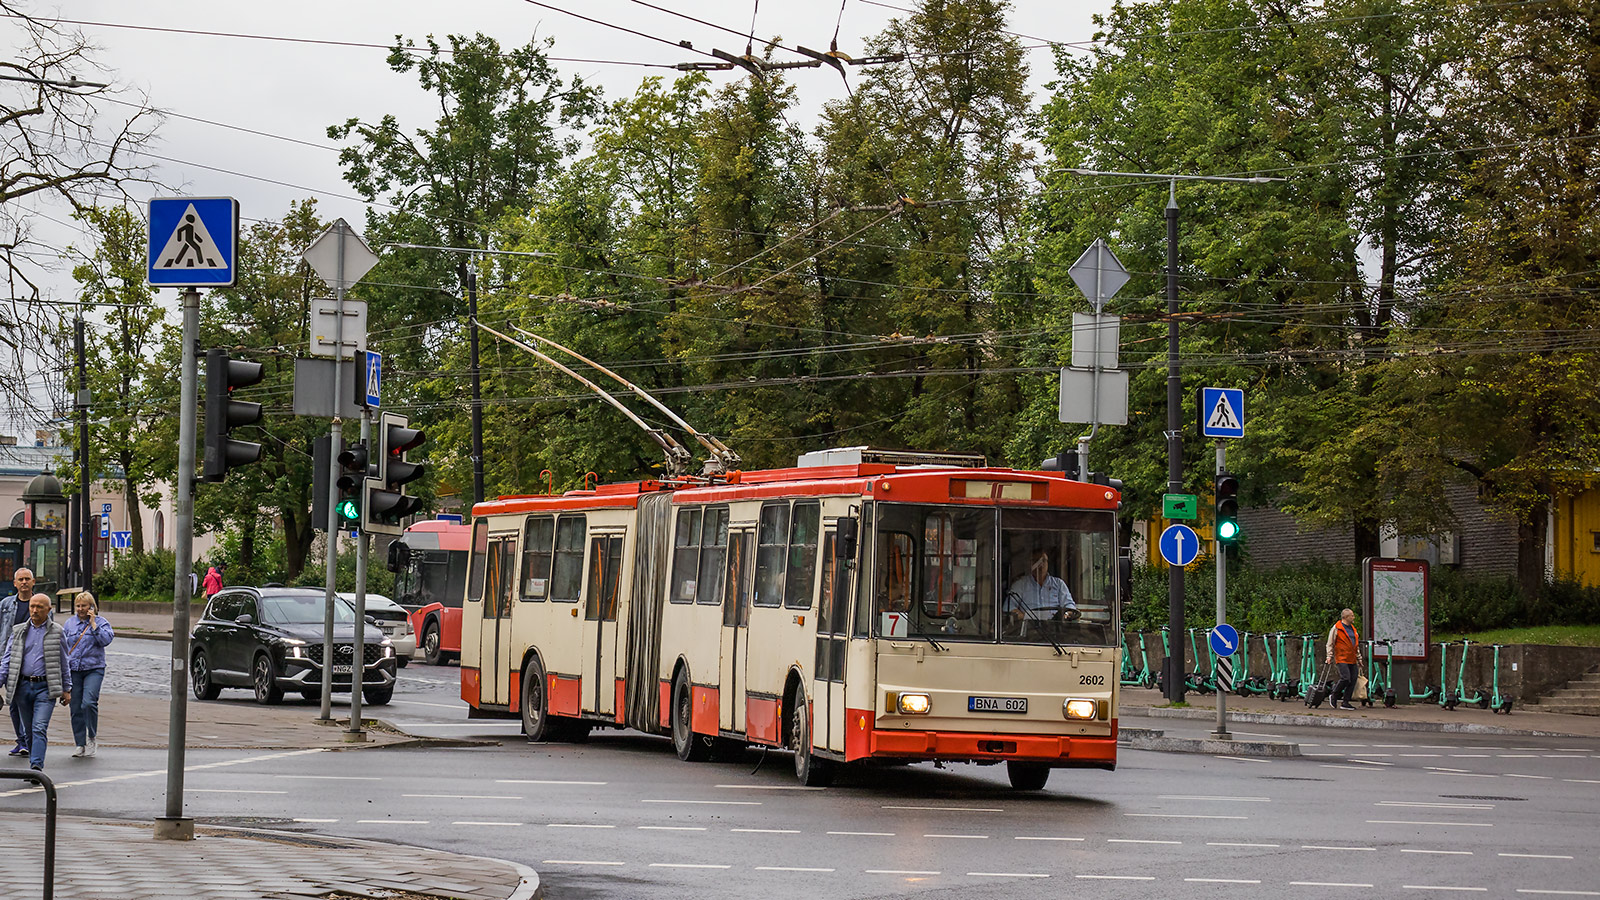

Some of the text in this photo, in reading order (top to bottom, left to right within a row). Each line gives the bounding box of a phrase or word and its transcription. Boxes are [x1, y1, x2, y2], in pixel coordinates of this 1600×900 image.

[888, 614, 899, 636] 7
[1079, 675, 1105, 686] 2602
[975, 699, 998, 710] BNA
[1005, 700, 1025, 711] 602
